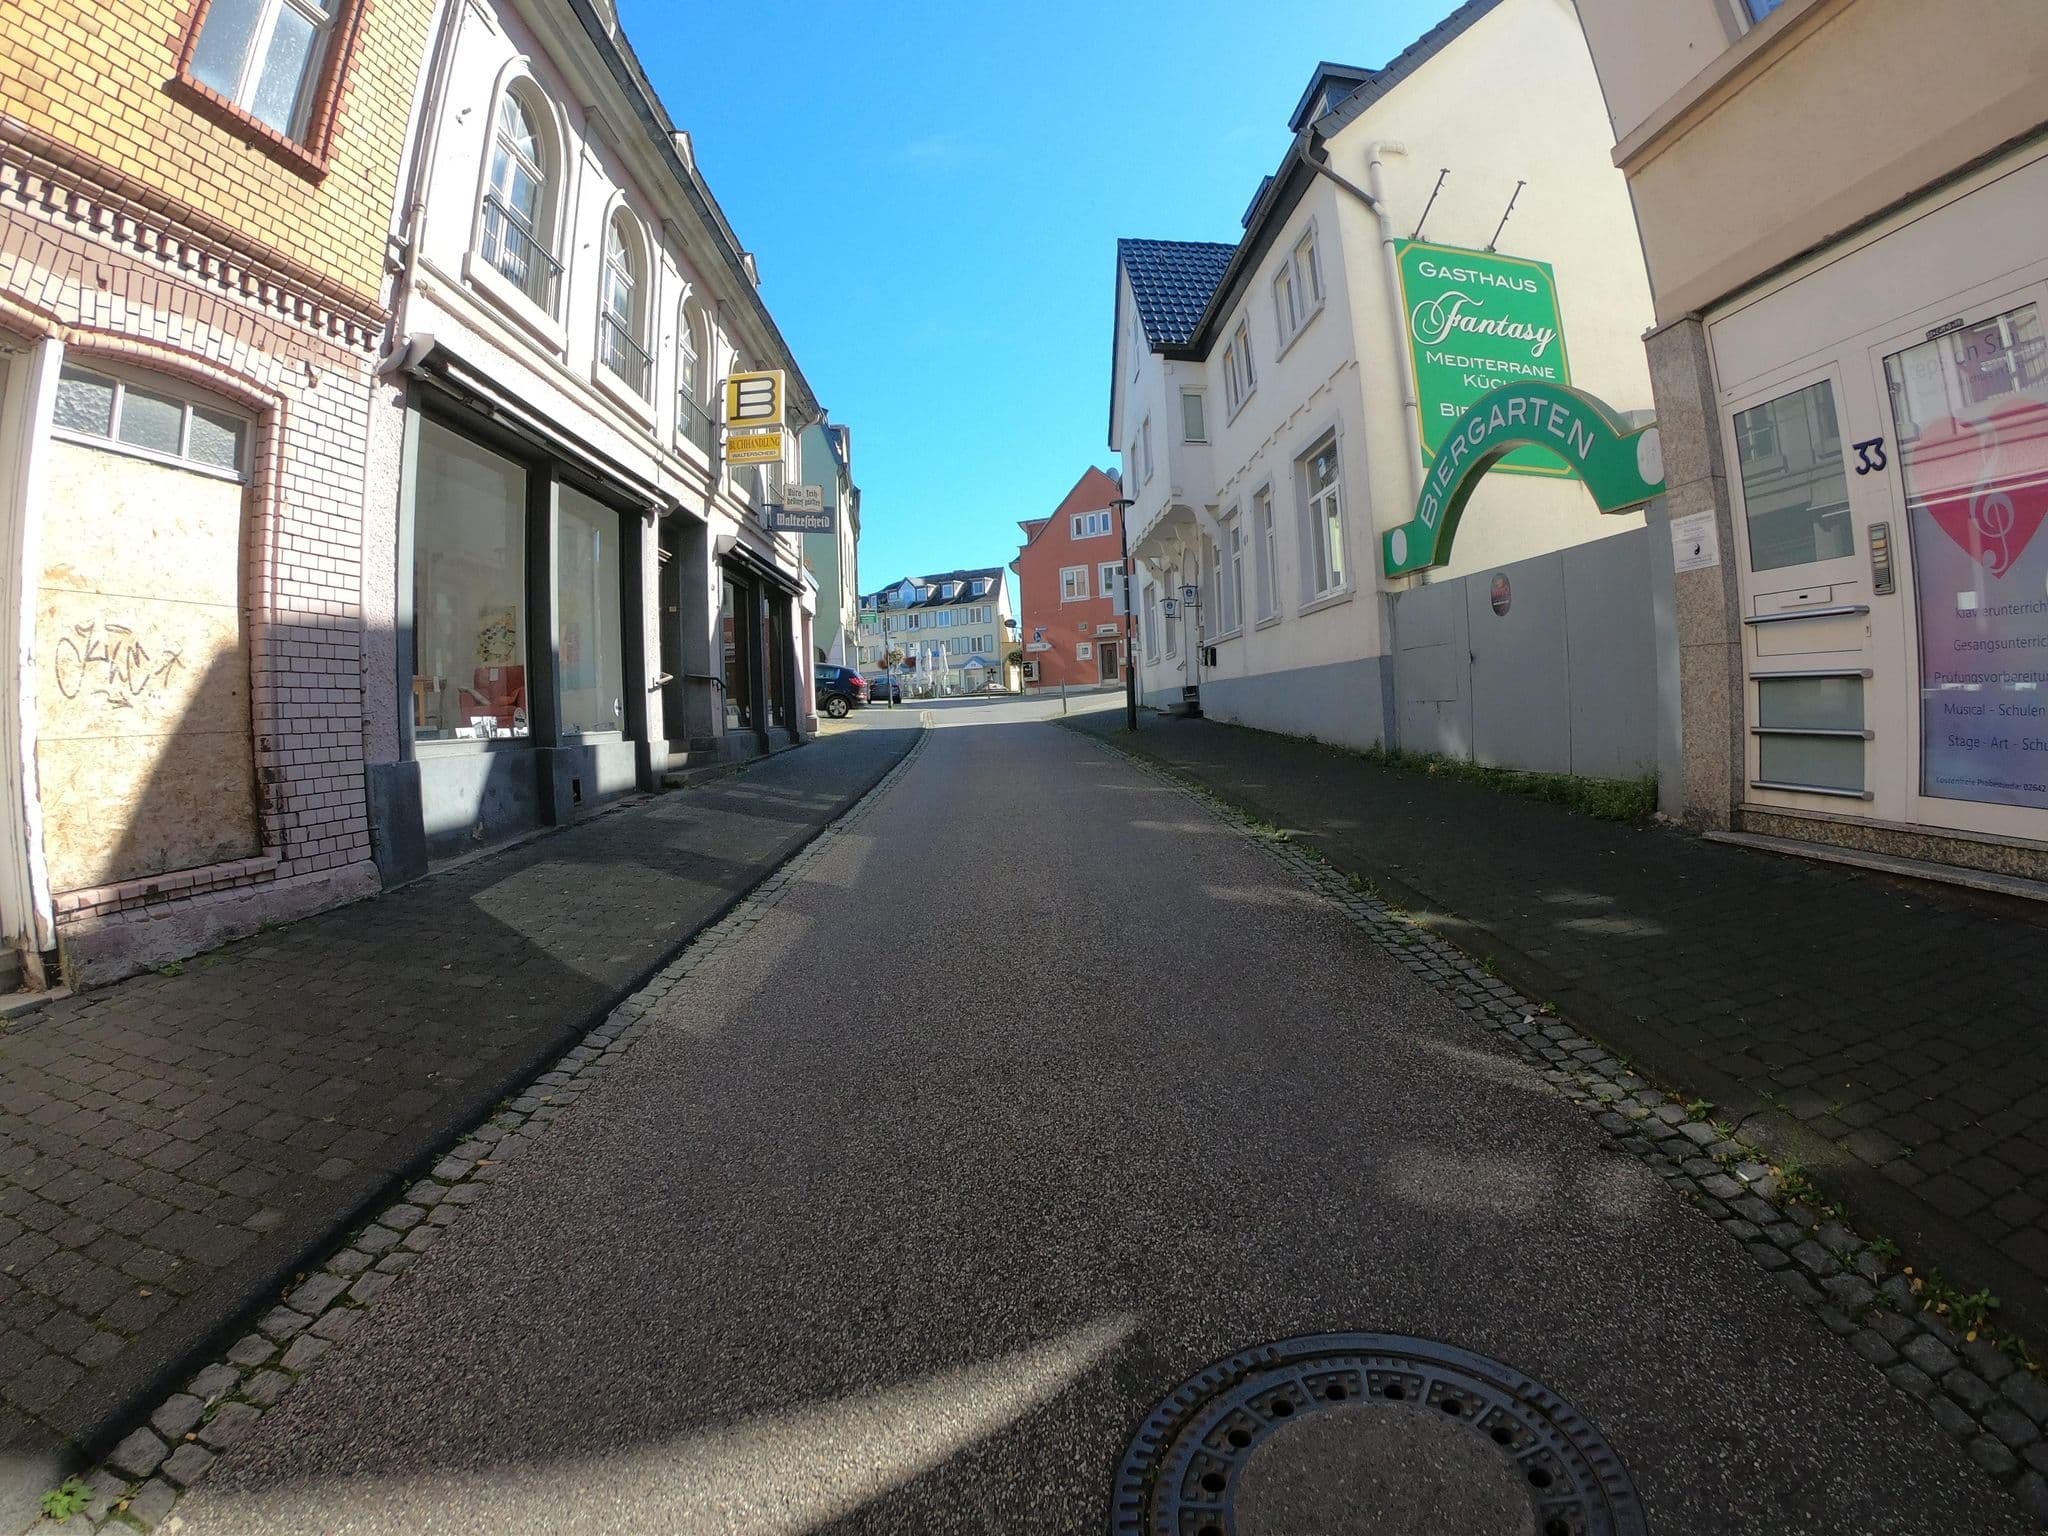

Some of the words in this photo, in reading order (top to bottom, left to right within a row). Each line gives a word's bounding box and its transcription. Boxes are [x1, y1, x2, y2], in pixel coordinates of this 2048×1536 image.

[1418, 261, 1538, 293] GASTHAUS
[1411, 290, 1557, 358] Fantasy
[1425, 351, 1556, 379] MEDITERRANE
[728, 436, 780, 450] BUCHHANDLUNG
[1420, 397, 1595, 530] BIERGARTEN
[1852, 437, 1888, 476] 33
[1955, 600, 2048, 618] Klaverunterrich
[1953, 637, 2048, 654] Gesangsunterric
[1944, 703, 1985, 716] Musical
[1948, 735, 1980, 751] Stage
[1991, 736, 2009, 750] Art
